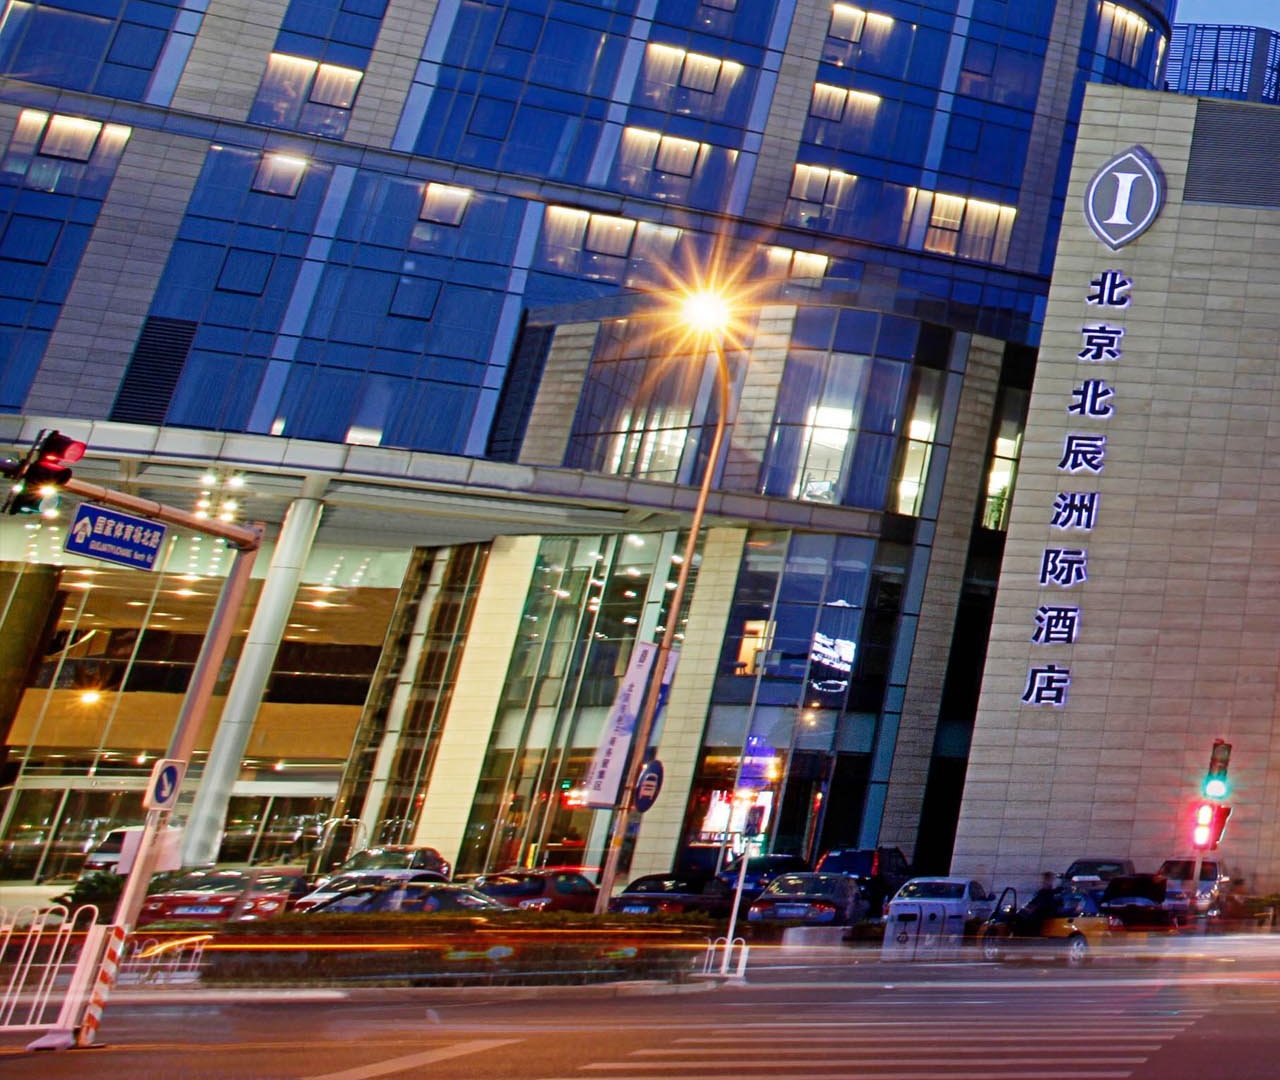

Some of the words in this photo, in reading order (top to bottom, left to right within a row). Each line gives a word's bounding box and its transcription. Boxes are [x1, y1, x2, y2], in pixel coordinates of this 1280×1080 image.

[1022, 269, 1133, 707] 北京北辰洲际酒店
